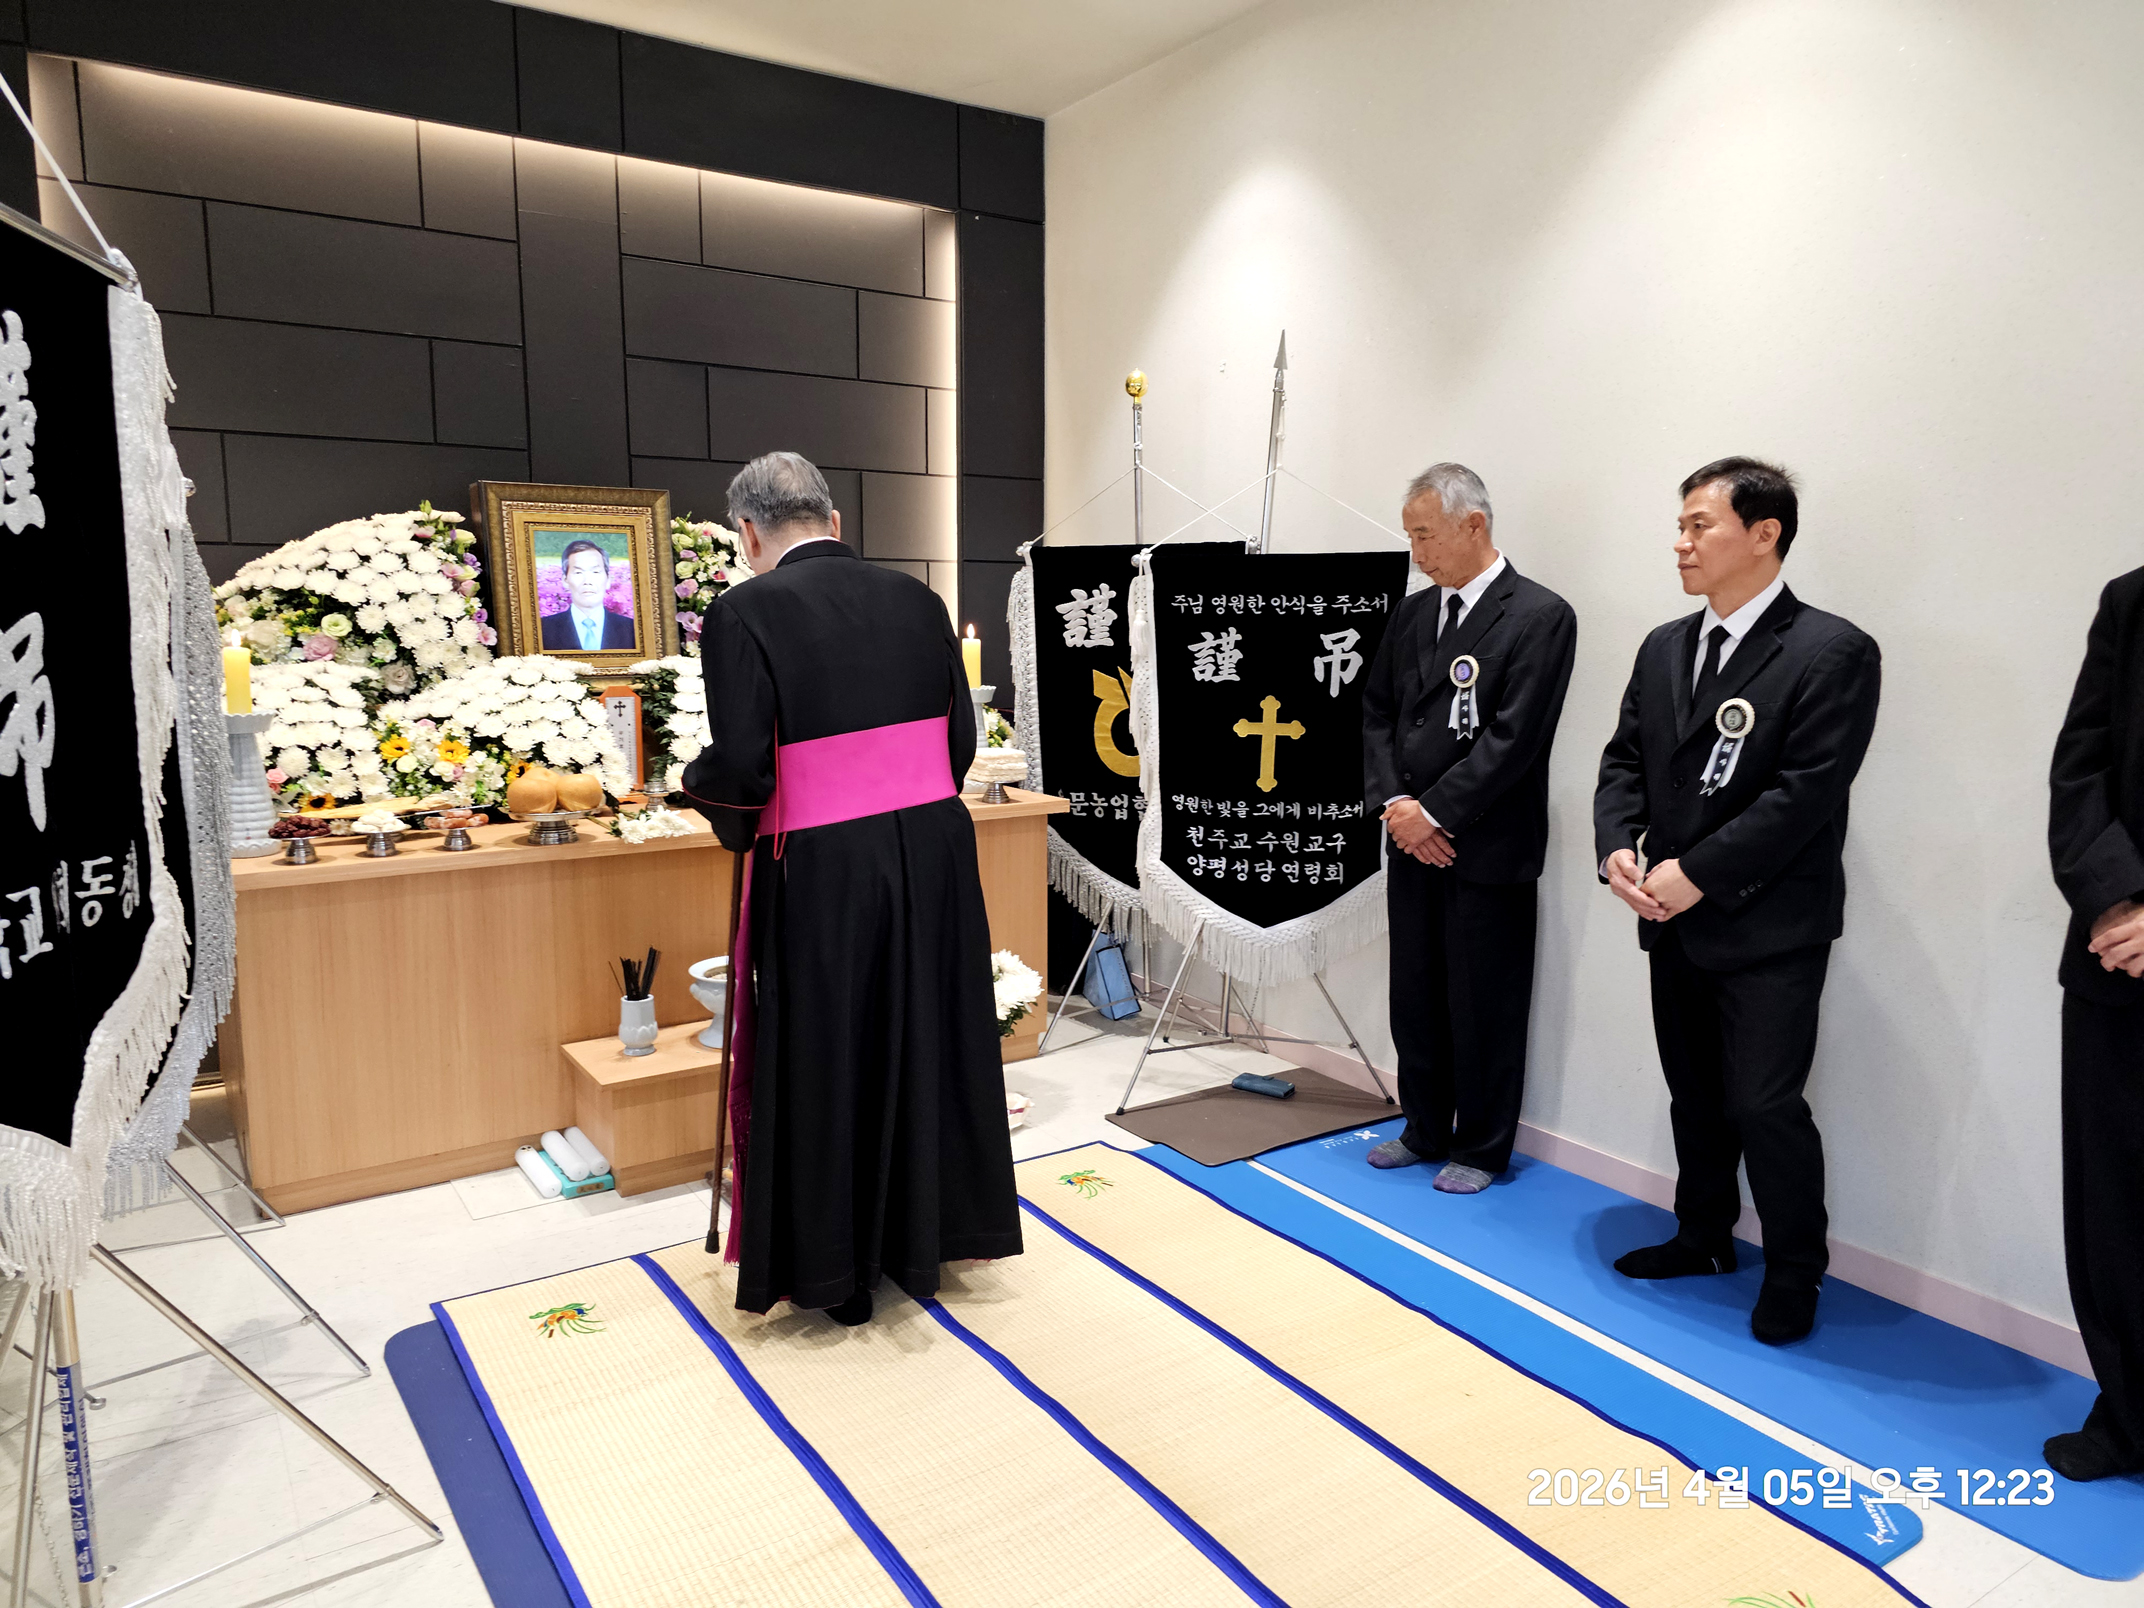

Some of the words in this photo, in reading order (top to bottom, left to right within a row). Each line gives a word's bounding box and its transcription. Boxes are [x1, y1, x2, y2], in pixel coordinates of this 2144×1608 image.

[1055, 583, 1119, 649] 謹
[1171, 594, 1203, 614] 주님
[1211, 594, 1266, 615] 영원한
[1270, 594, 1327, 616] 안식을
[1331, 593, 1388, 614] 주소서
[1187, 626, 1244, 683] 謹
[1058, 789, 1149, 822] 문농업협
[1172, 794, 1214, 816] 영원한
[1216, 800, 1250, 819] 빛을
[1252, 801, 1301, 820] 그에게
[1307, 800, 1364, 821] 비추소서
[1186, 825, 1252, 850] 천주교
